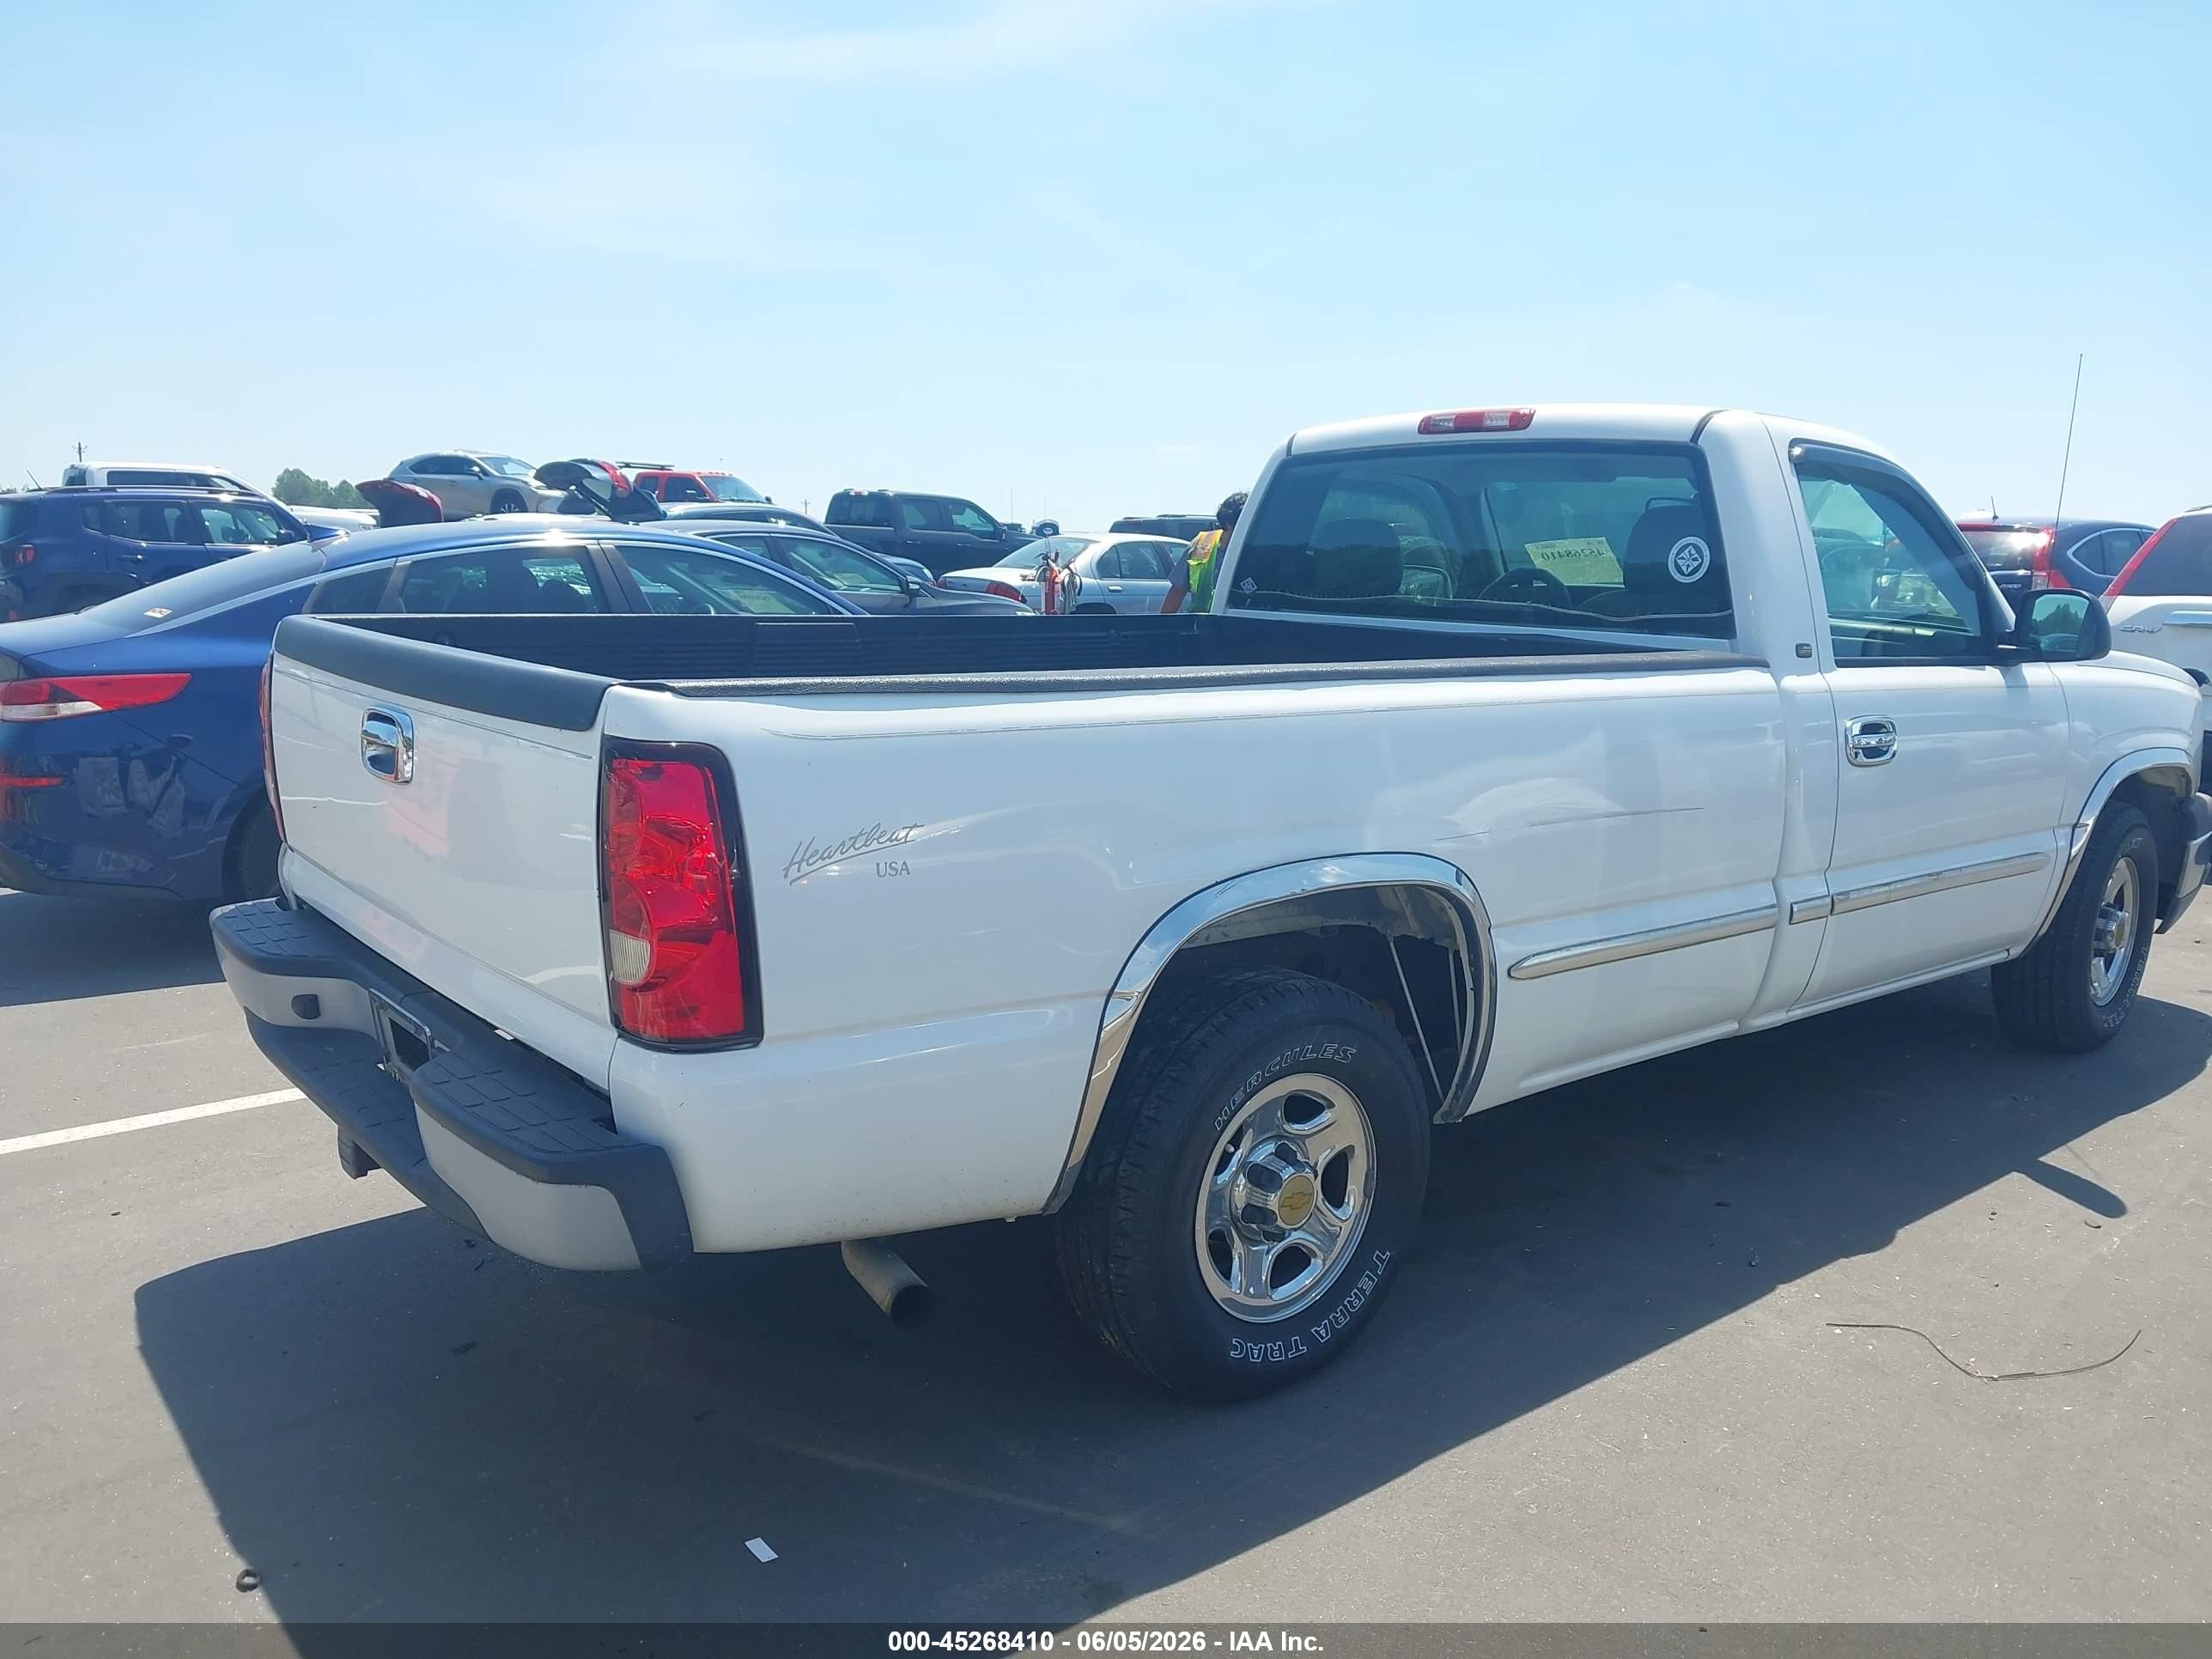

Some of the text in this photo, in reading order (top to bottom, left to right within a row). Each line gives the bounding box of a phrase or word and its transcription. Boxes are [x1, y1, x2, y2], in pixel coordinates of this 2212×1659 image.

[782, 822, 926, 880] Heartbeat
[875, 859, 911, 878] USA
[1213, 1042, 1358, 1132] HERCULES
[1230, 1249, 1391, 1363] TERRA TRAC
